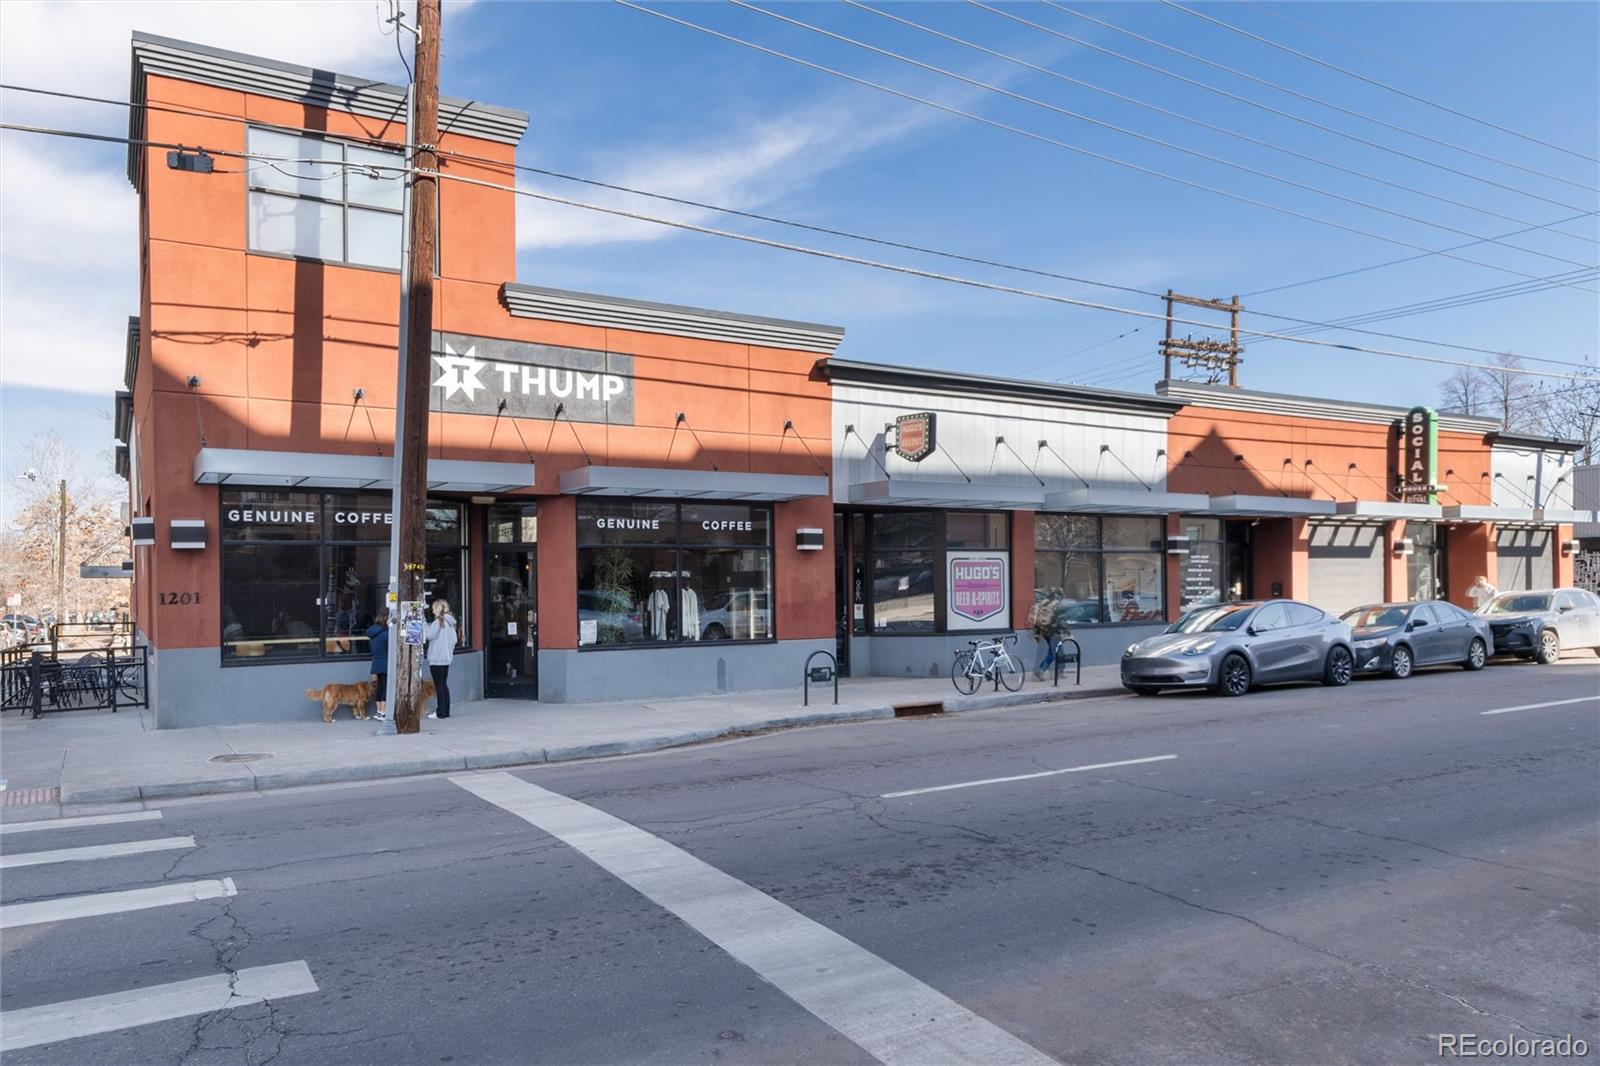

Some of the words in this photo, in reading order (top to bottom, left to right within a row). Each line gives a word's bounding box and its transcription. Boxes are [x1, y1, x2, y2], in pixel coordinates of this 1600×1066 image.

[495, 363, 625, 401] THUMP
[1411, 413, 1424, 482] SOCIAL
[228, 510, 315, 523] GENUINE
[335, 512, 393, 524] COFFE
[597, 518, 660, 529] GENUINE
[702, 520, 752, 531] COFFEE
[955, 565, 1000, 579] HUGO'S
[159, 591, 201, 605] 1201
[955, 592, 970, 606] BEER
[978, 592, 1000, 605] SPIRITS
